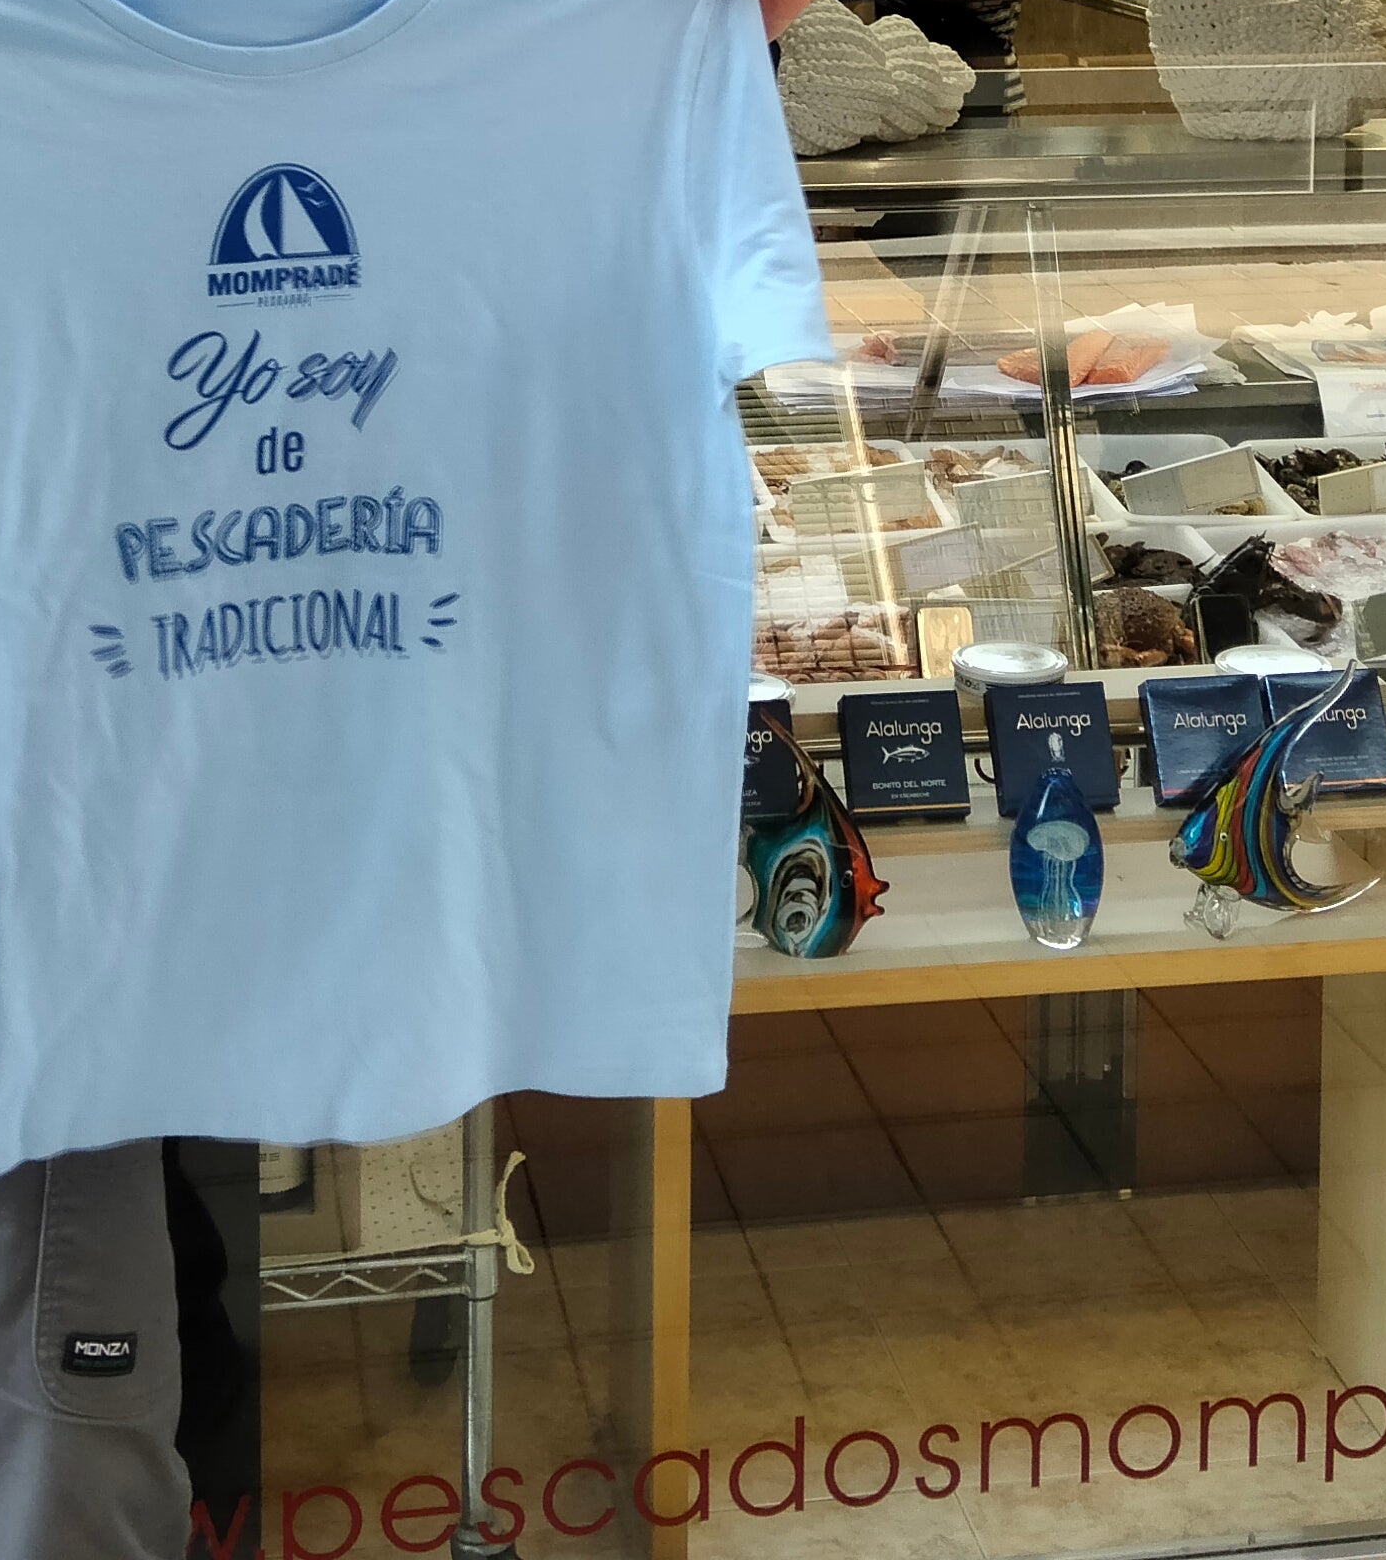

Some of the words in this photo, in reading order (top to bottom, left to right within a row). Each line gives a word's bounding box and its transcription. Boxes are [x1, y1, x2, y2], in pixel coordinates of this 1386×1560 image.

[208, 255, 361, 297] MOMPRADÉ
[164, 329, 285, 449] Yo
[286, 345, 398, 432] soy
[256, 427, 305, 475] de
[116, 485, 442, 584] PESCADERÍA
[149, 590, 410, 680] TRADICIONAL
[866, 720, 942, 744] Alalunga
[1016, 712, 1091, 737] Alalunga
[1174, 712, 1247, 735] Alalunga
[872, 781, 901, 790] BONITO
[904, 780, 918, 788] DEL
[921, 779, 946, 788] NORTE
[74, 1341, 130, 1356] MONZA
